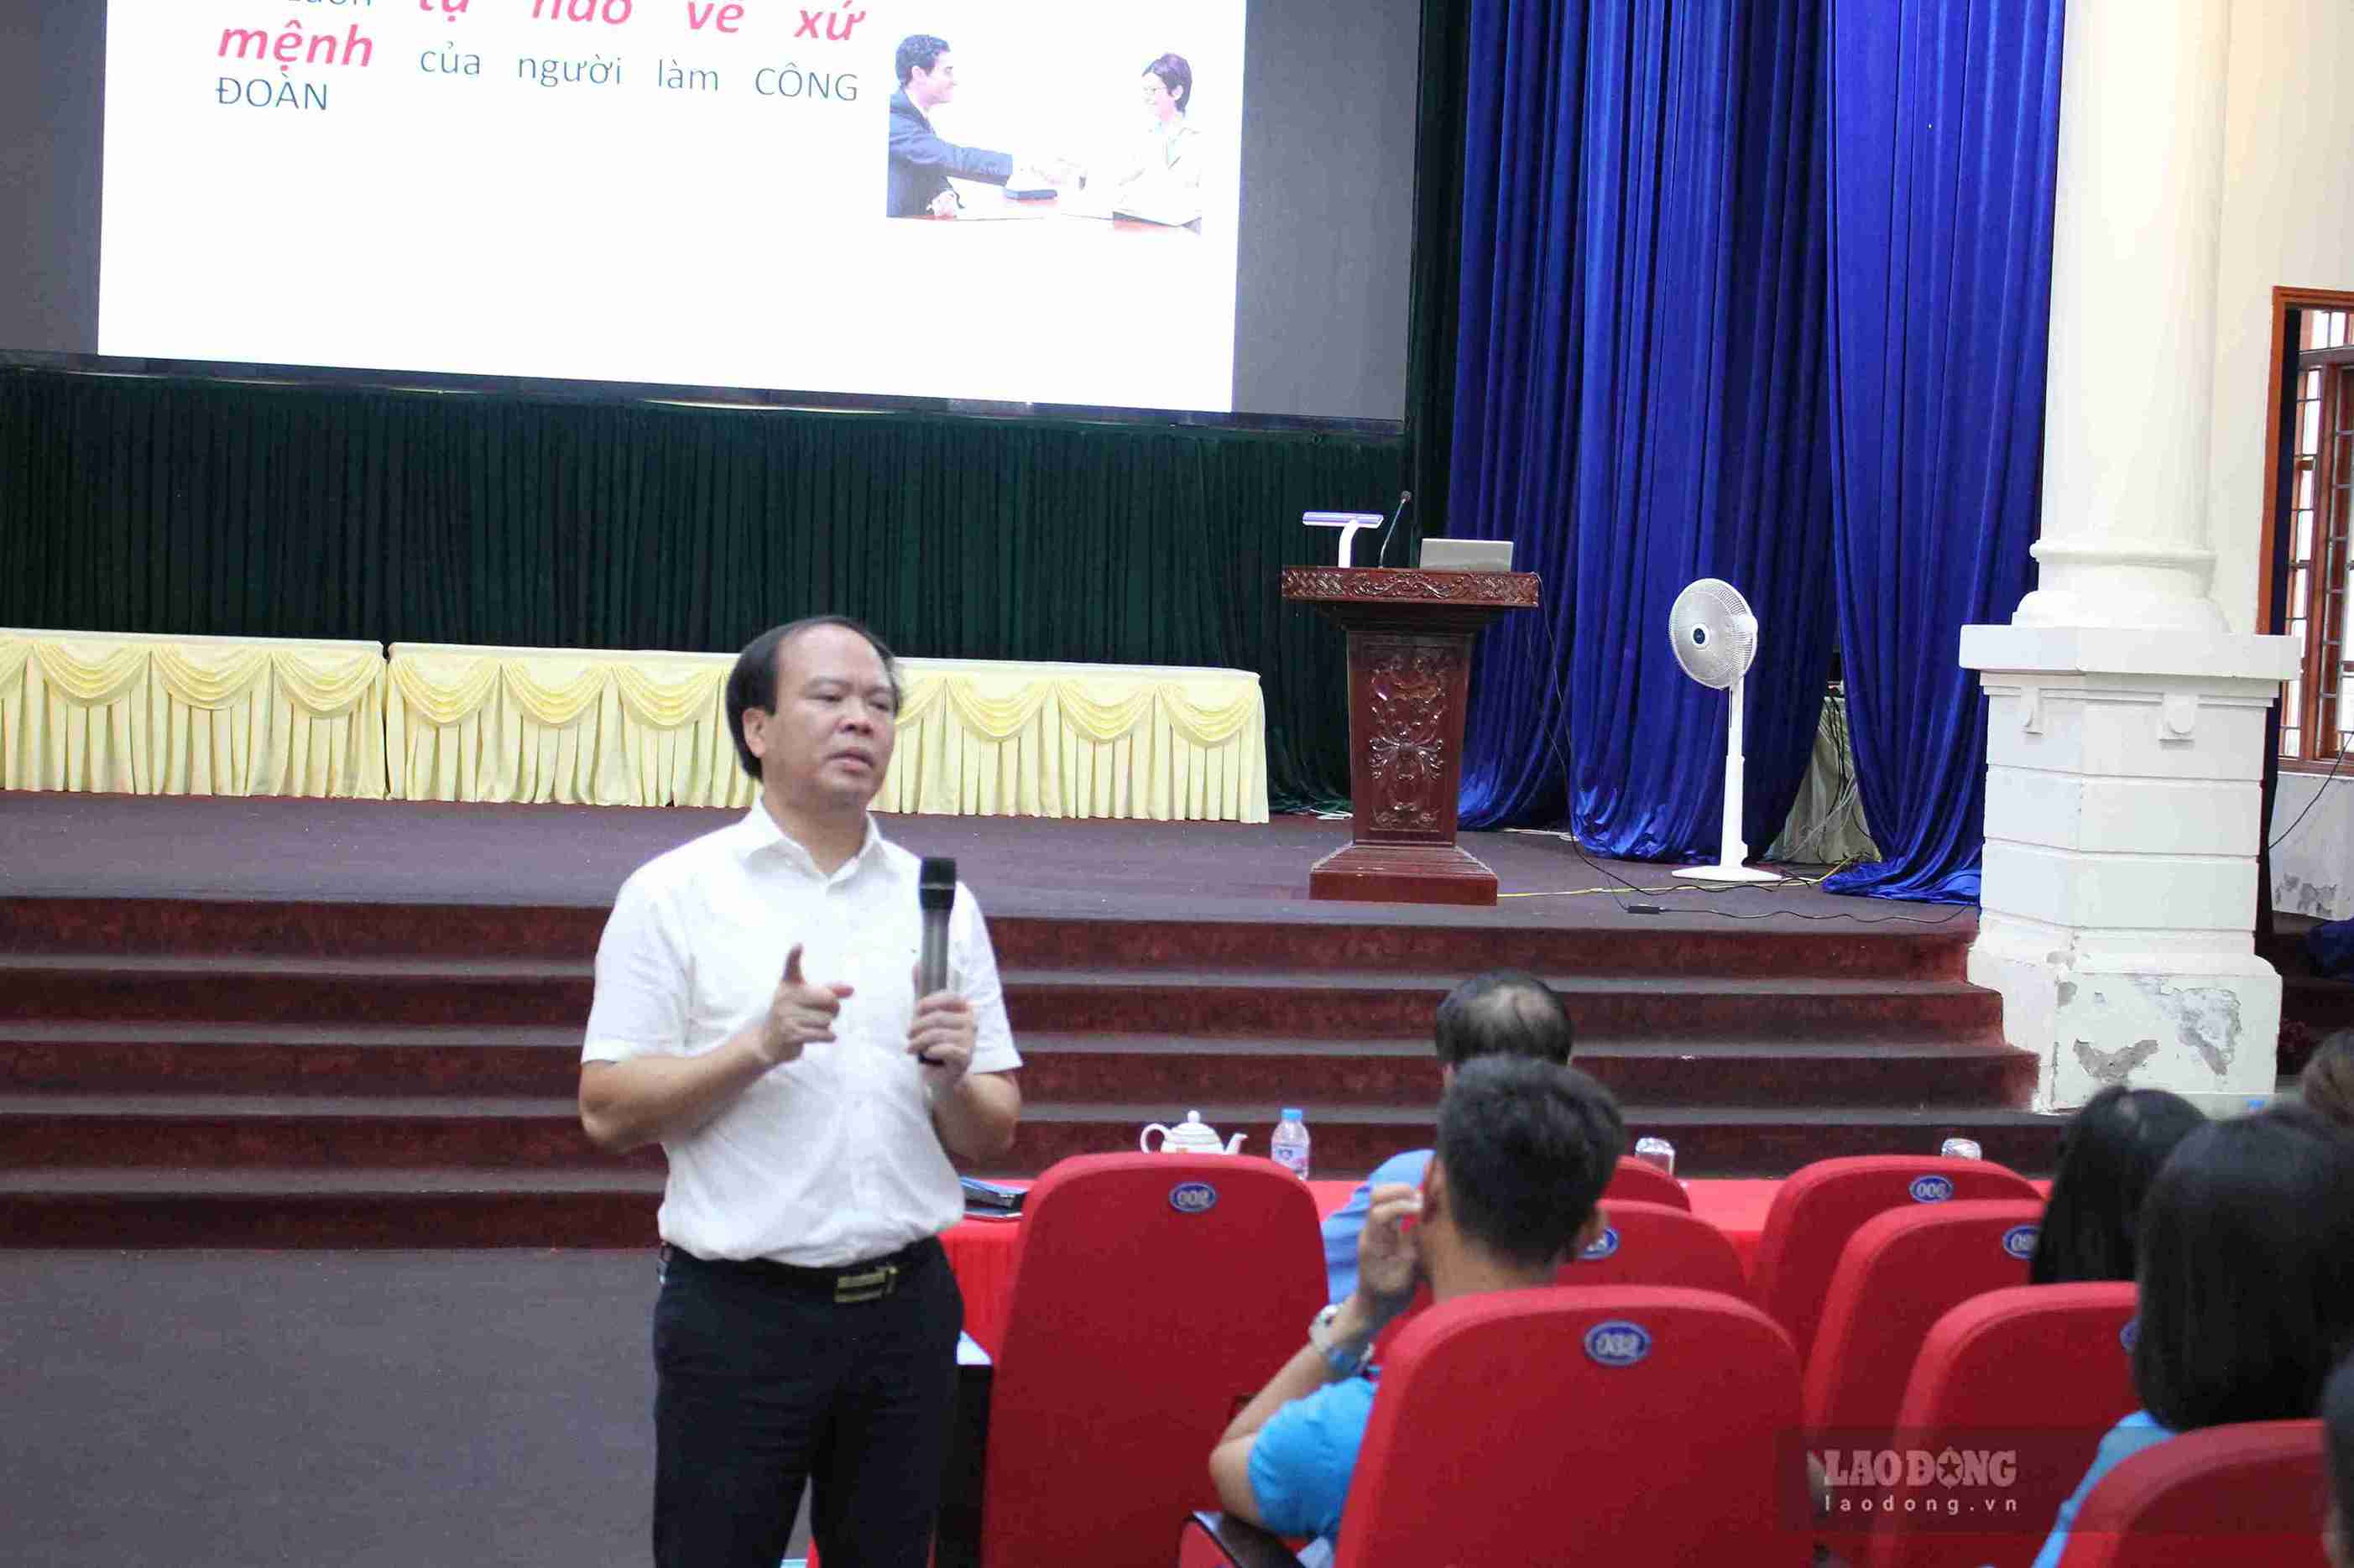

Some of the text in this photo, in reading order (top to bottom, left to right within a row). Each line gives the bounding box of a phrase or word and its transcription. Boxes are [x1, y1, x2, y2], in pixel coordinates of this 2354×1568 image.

[794, 0, 866, 40] xứ
[218, 20, 857, 101] mệnh của người làm CÔNG
[215, 72, 327, 111] ĐOÀN
